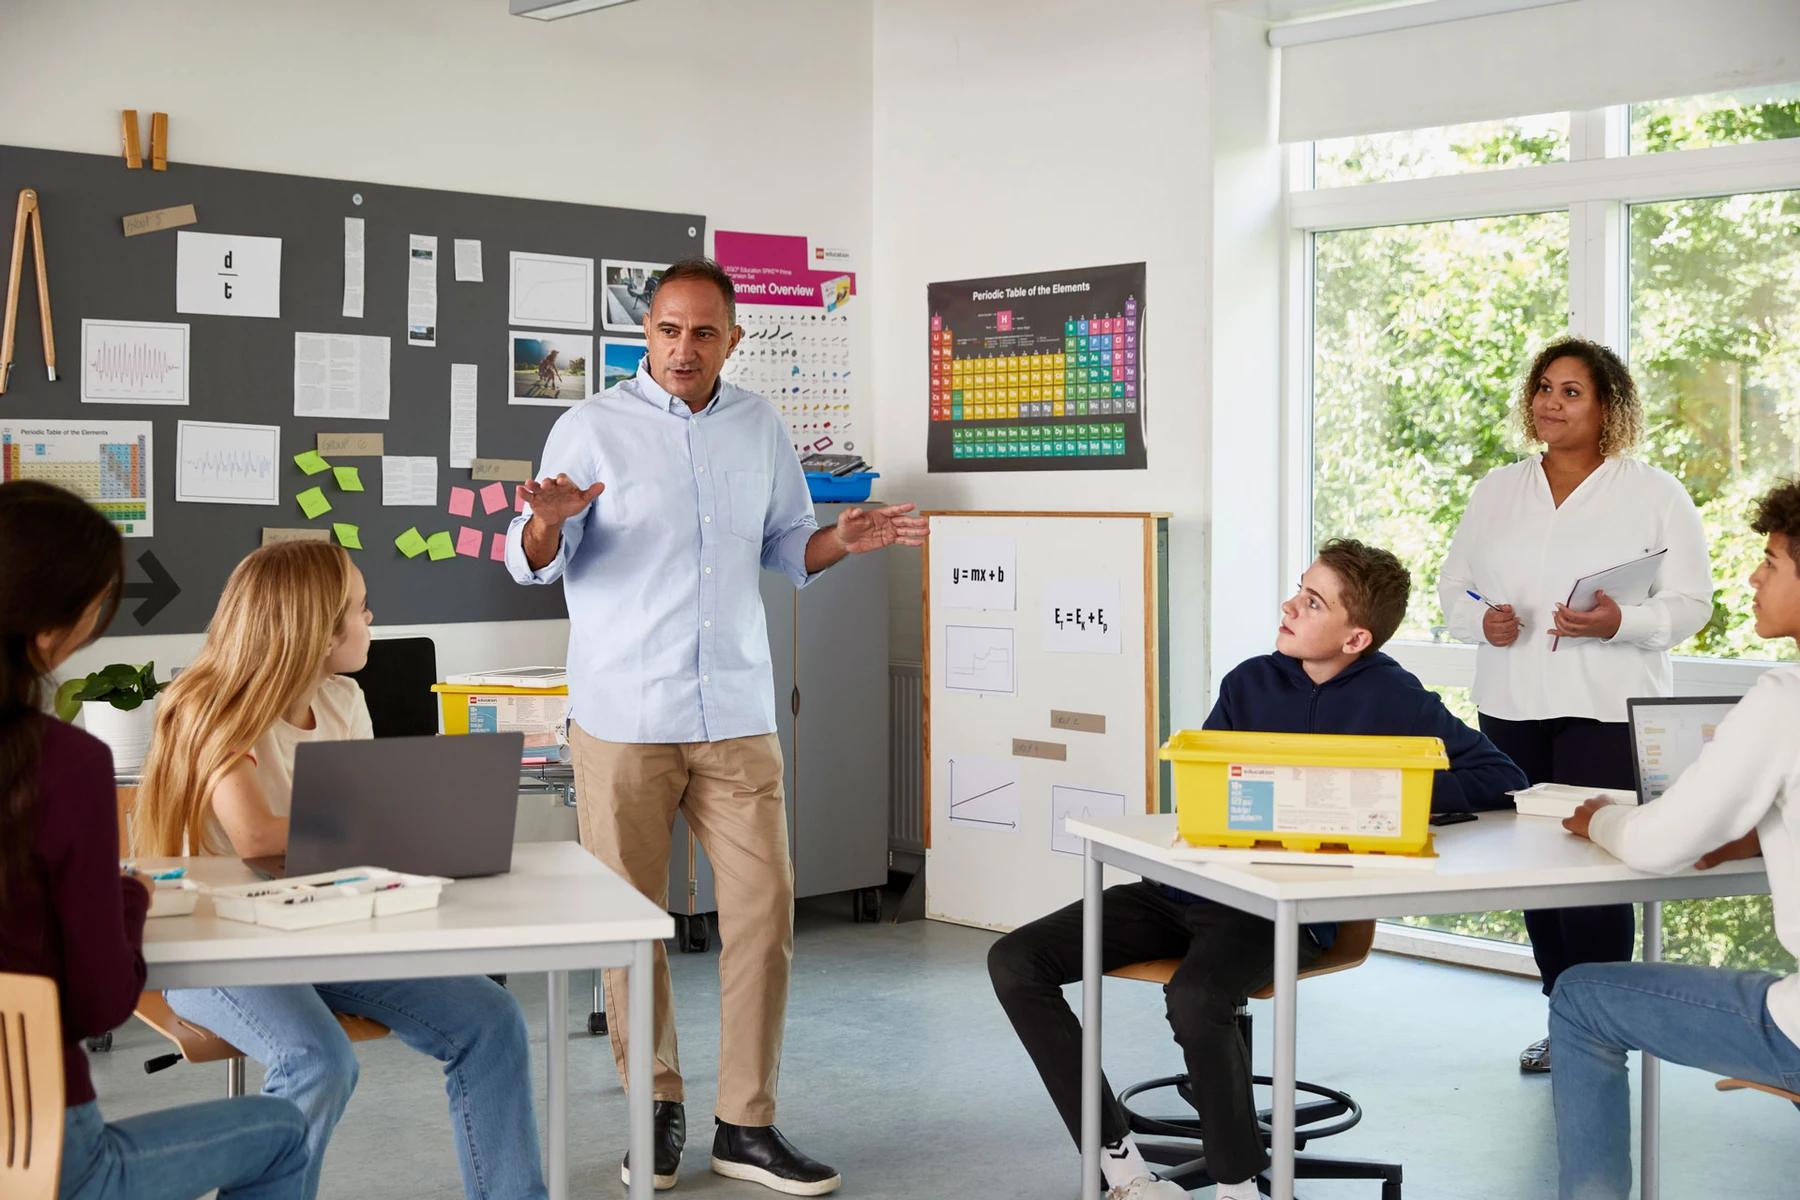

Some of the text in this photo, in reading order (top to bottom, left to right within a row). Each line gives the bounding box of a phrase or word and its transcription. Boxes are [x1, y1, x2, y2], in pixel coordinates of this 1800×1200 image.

[224, 250, 232, 269] d
[224, 282, 232, 299] t
[768, 282, 814, 296] Overview
[972, 282, 1090, 301] Periodic Table of the Elements
[1002, 315, 1007, 323] H
[953, 568, 959, 584] y
[971, 568, 986, 582] mx
[998, 566, 1004, 582] b
